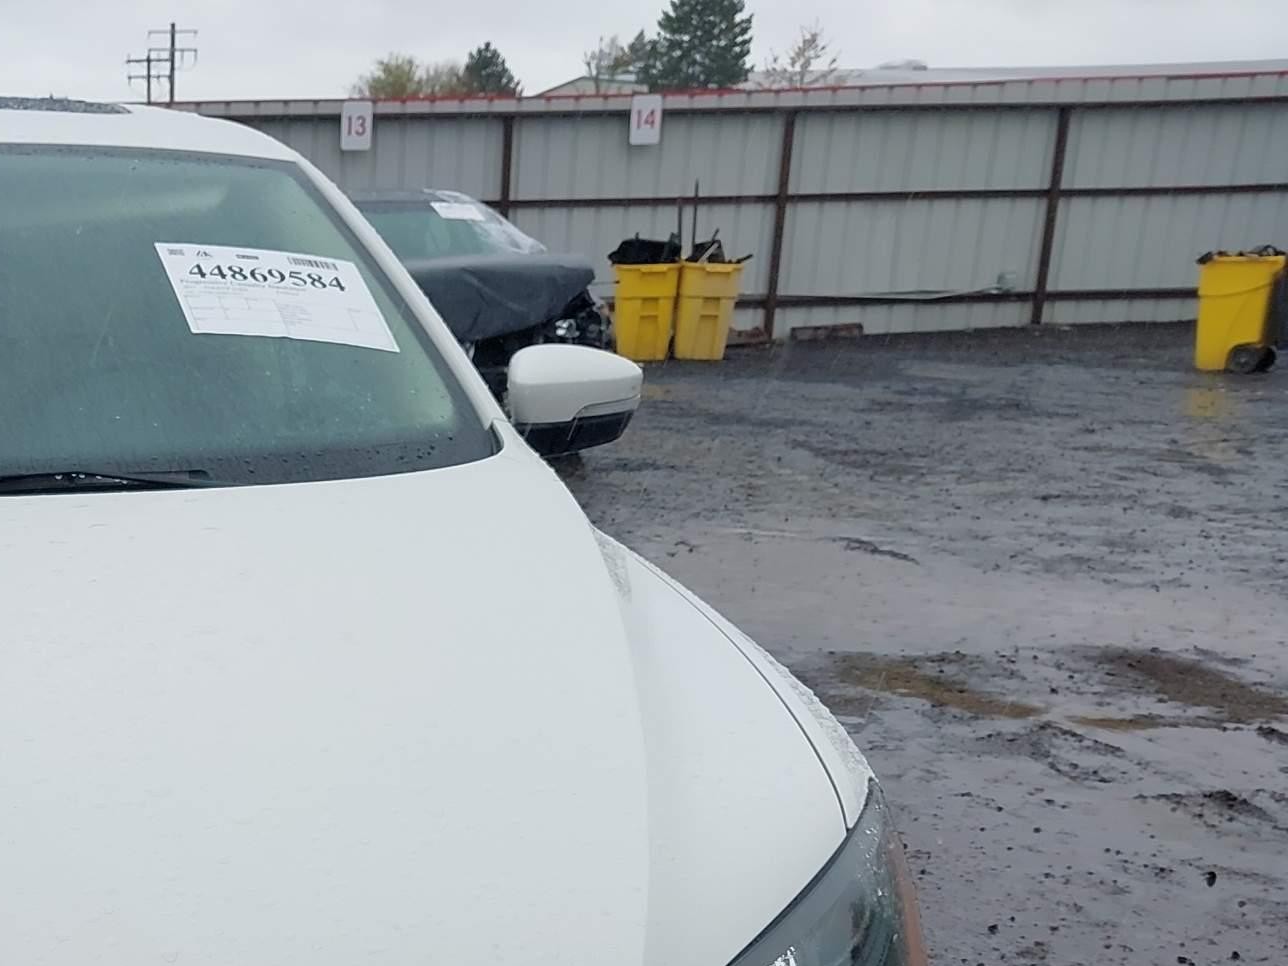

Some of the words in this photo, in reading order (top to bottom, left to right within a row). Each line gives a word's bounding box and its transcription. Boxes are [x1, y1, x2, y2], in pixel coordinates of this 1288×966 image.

[347, 114, 367, 137] 13
[637, 109, 656, 129] 14
[188, 263, 346, 293] 44869584
